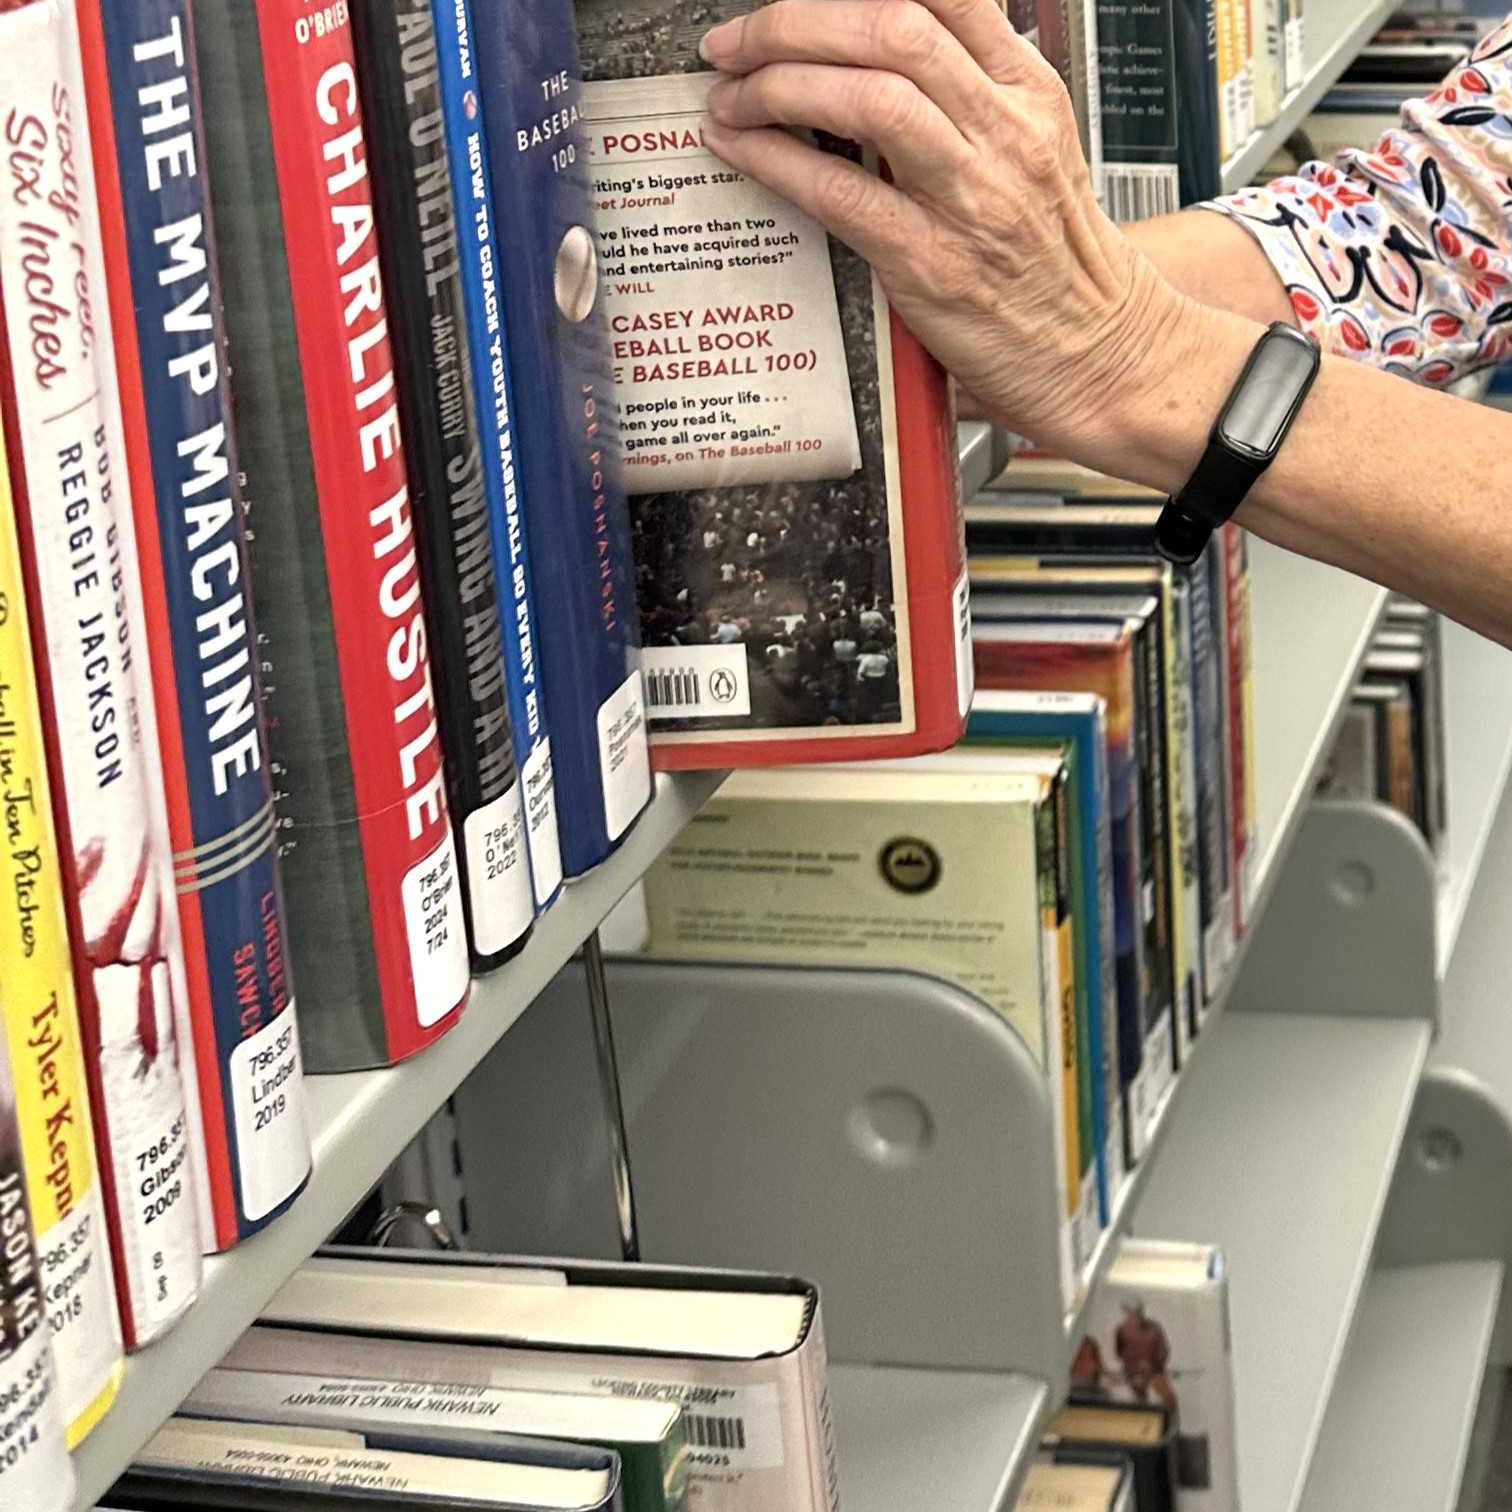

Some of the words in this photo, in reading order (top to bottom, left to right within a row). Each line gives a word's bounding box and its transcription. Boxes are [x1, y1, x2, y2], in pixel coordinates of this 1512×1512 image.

[133, 14, 197, 192] THE
[541, 70, 570, 102] THE
[5, 106, 50, 207] Six
[467, 132, 486, 200] HOW
[552, 143, 576, 173] 100
[620, 193, 676, 210] Journal
[648, 173, 708, 190] biggest
[474, 203, 489, 242] TO
[622, 225, 659, 240] lived
[663, 224, 703, 236] more
[707, 220, 742, 233] than
[745, 217, 776, 230] two
[630, 242, 649, 255] he
[653, 240, 689, 255] have
[693, 235, 760, 252] acquired
[764, 232, 799, 246] such
[630, 253, 724, 275] entertaining
[20, 220, 71, 390] Inches
[153, 212, 221, 397] MVP
[479, 245, 501, 335] COACH
[615, 281, 655, 295] WILL
[611, 310, 694, 333] CASEY
[701, 303, 794, 327] AWARD
[430, 313, 458, 368] JACK
[614, 336, 692, 359] EBALL
[698, 330, 774, 353] BOOK
[489, 338, 510, 430] YOUTH
[633, 357, 758, 383] BASEBALL
[764, 349, 818, 372] 100)
[437, 368, 466, 441] CURRY
[582, 383, 596, 438] JOE
[626, 399, 678, 414] people
[682, 395, 696, 408] in
[700, 395, 734, 411] your
[737, 391, 761, 405] life
[651, 416, 678, 430] you
[683, 412, 717, 426] read
[720, 411, 737, 424] it,
[315, 60, 403, 472] CHARLIE
[368, 484, 448, 843] HUSTLE
[625, 437, 667, 452] game
[671, 433, 689, 445] all
[693, 431, 726, 443] over
[675, 449, 695, 461] on
[699, 447, 725, 460] The
[730, 441, 792, 458] Baseball
[795, 439, 822, 452] 100
[58, 441, 100, 598] REGGIE
[499, 433, 524, 565] BASEBALL
[446, 443, 495, 604] SWING
[587, 447, 615, 632] POSNANSKI
[177, 420, 261, 797] MACHINE
[463, 603, 506, 703] AND
[516, 599, 535, 684] EVERY
[78, 612, 123, 790] JACKSON
[525, 688, 540, 736] KID
[473, 707, 508, 746] A
[487, 849, 517, 881] 2022
[28, 990, 64, 1101] Tyler
[254, 1093, 287, 1133] 2019
[0, 1171, 33, 1285] JASON
[282, 1392, 360, 1409] LIBRARY
[360, 1394, 422, 1413] PUBLIC
[422, 1398, 501, 1417] NEWARK
